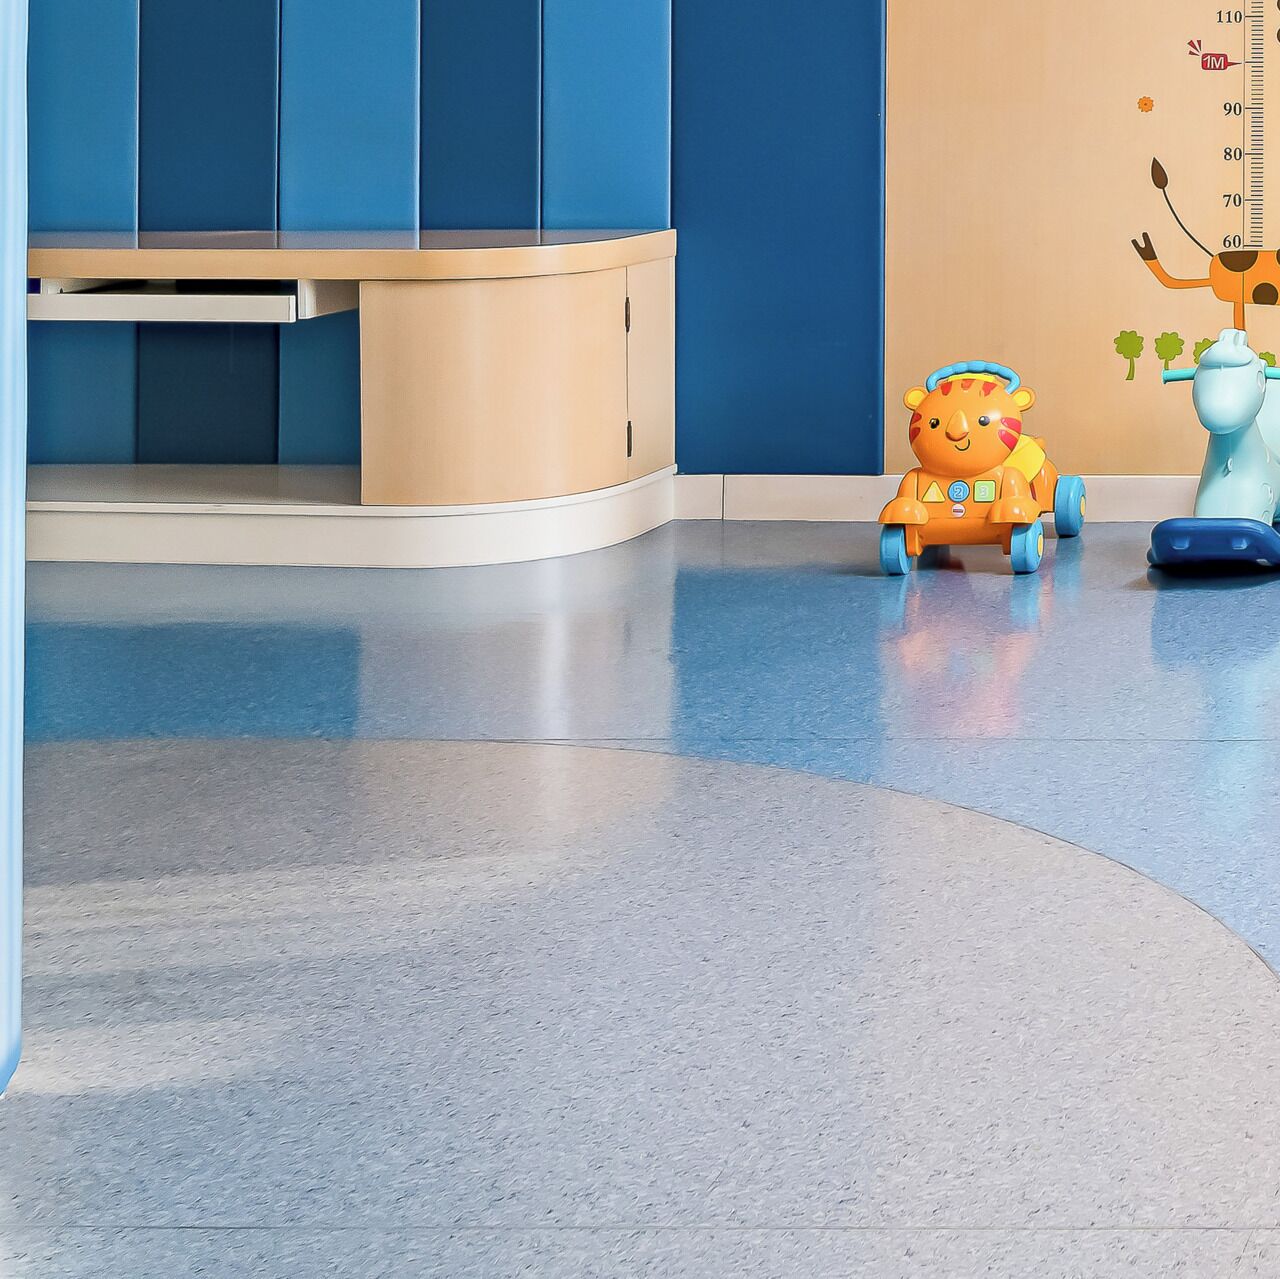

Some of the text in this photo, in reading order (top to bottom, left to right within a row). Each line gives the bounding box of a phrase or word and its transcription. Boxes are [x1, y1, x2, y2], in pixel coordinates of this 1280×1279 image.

[1216, 10, 1243, 24] 110
[1203, 55, 1225, 69] 1M
[1223, 102, 1242, 116] 90
[1223, 147, 1243, 161] 80
[1222, 193, 1242, 208] 70
[1222, 234, 1242, 249] 60
[953, 486, 963, 498] 2
[978, 485, 988, 497] 3
